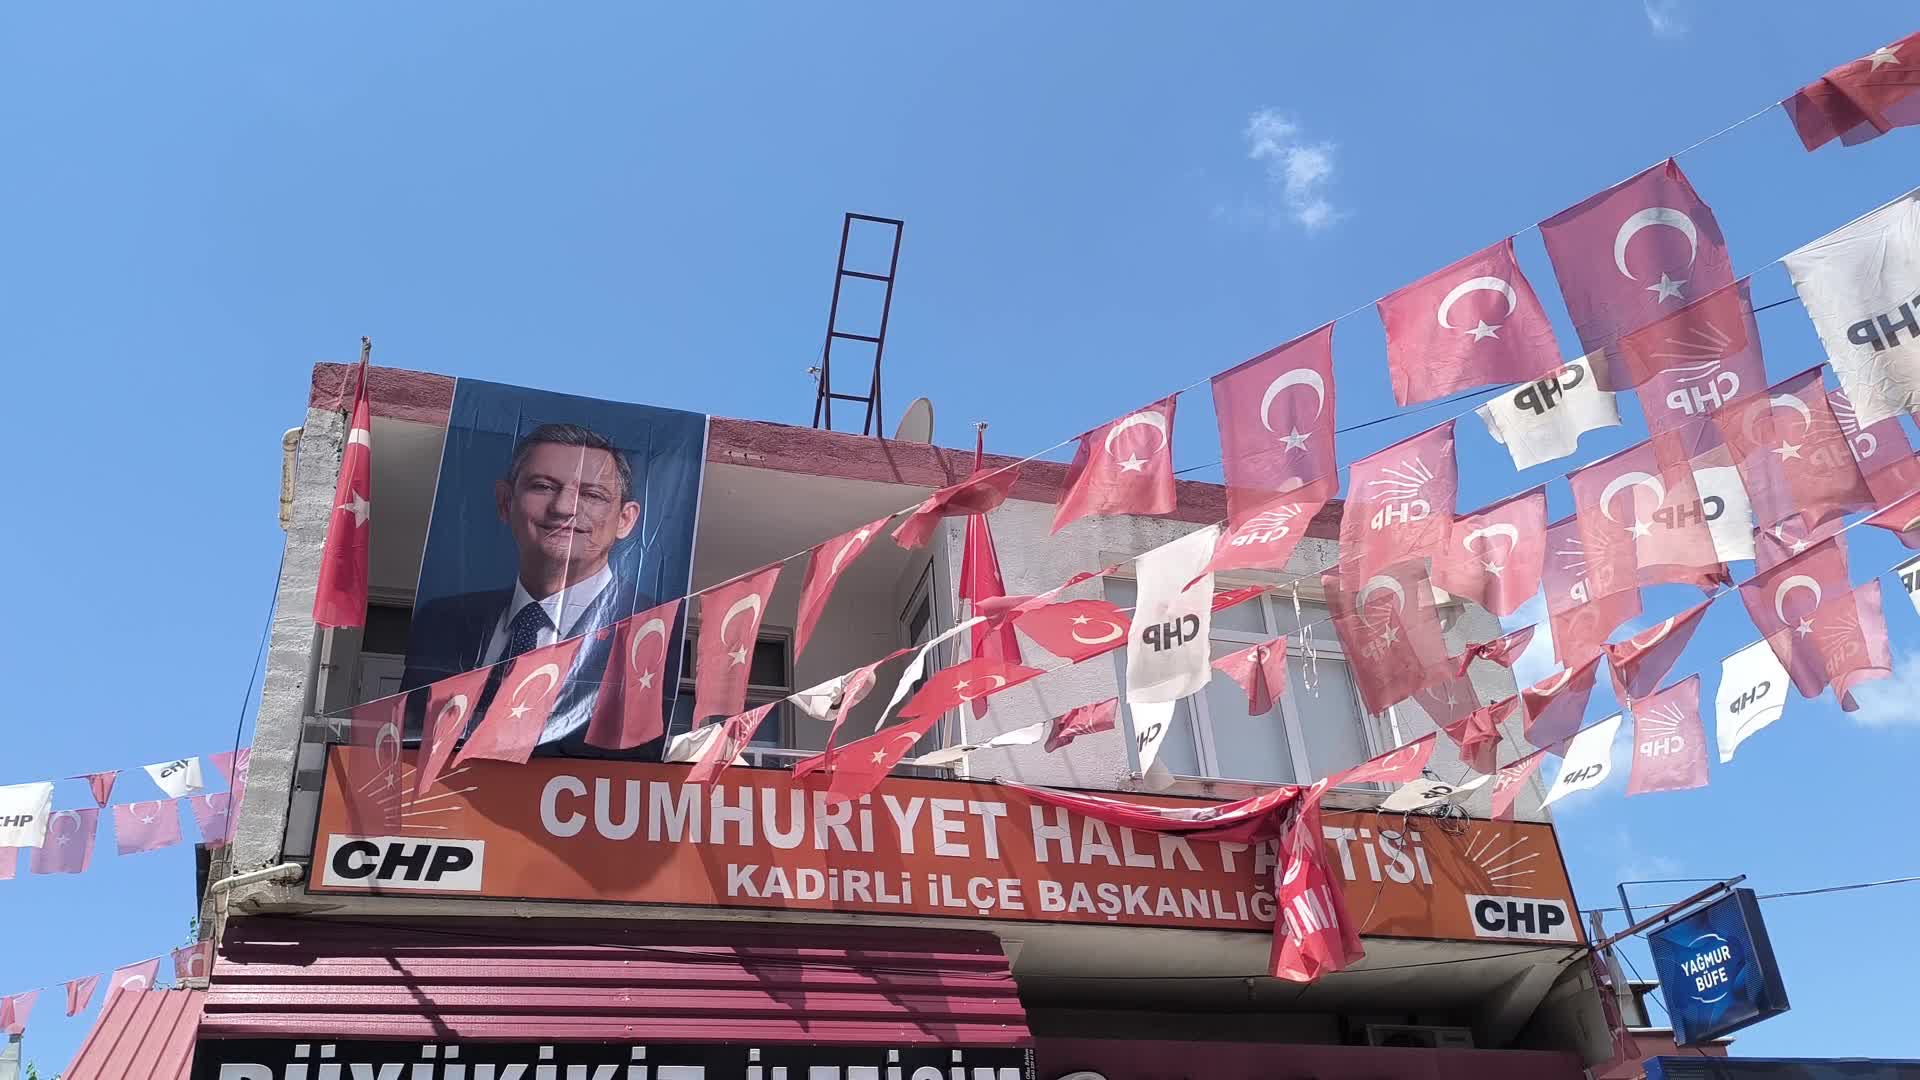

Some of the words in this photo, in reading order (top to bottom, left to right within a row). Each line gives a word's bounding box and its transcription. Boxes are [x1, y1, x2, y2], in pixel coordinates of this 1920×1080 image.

[1030, 804, 1204, 872] HALK
[332, 840, 474, 882] CHP
[1038, 880, 1277, 922] BAŞKANLIĞ
[1475, 899, 1565, 934] CHP
[1681, 945, 1731, 977] YAĞMUR
[1695, 967, 1728, 992] BÜFE
